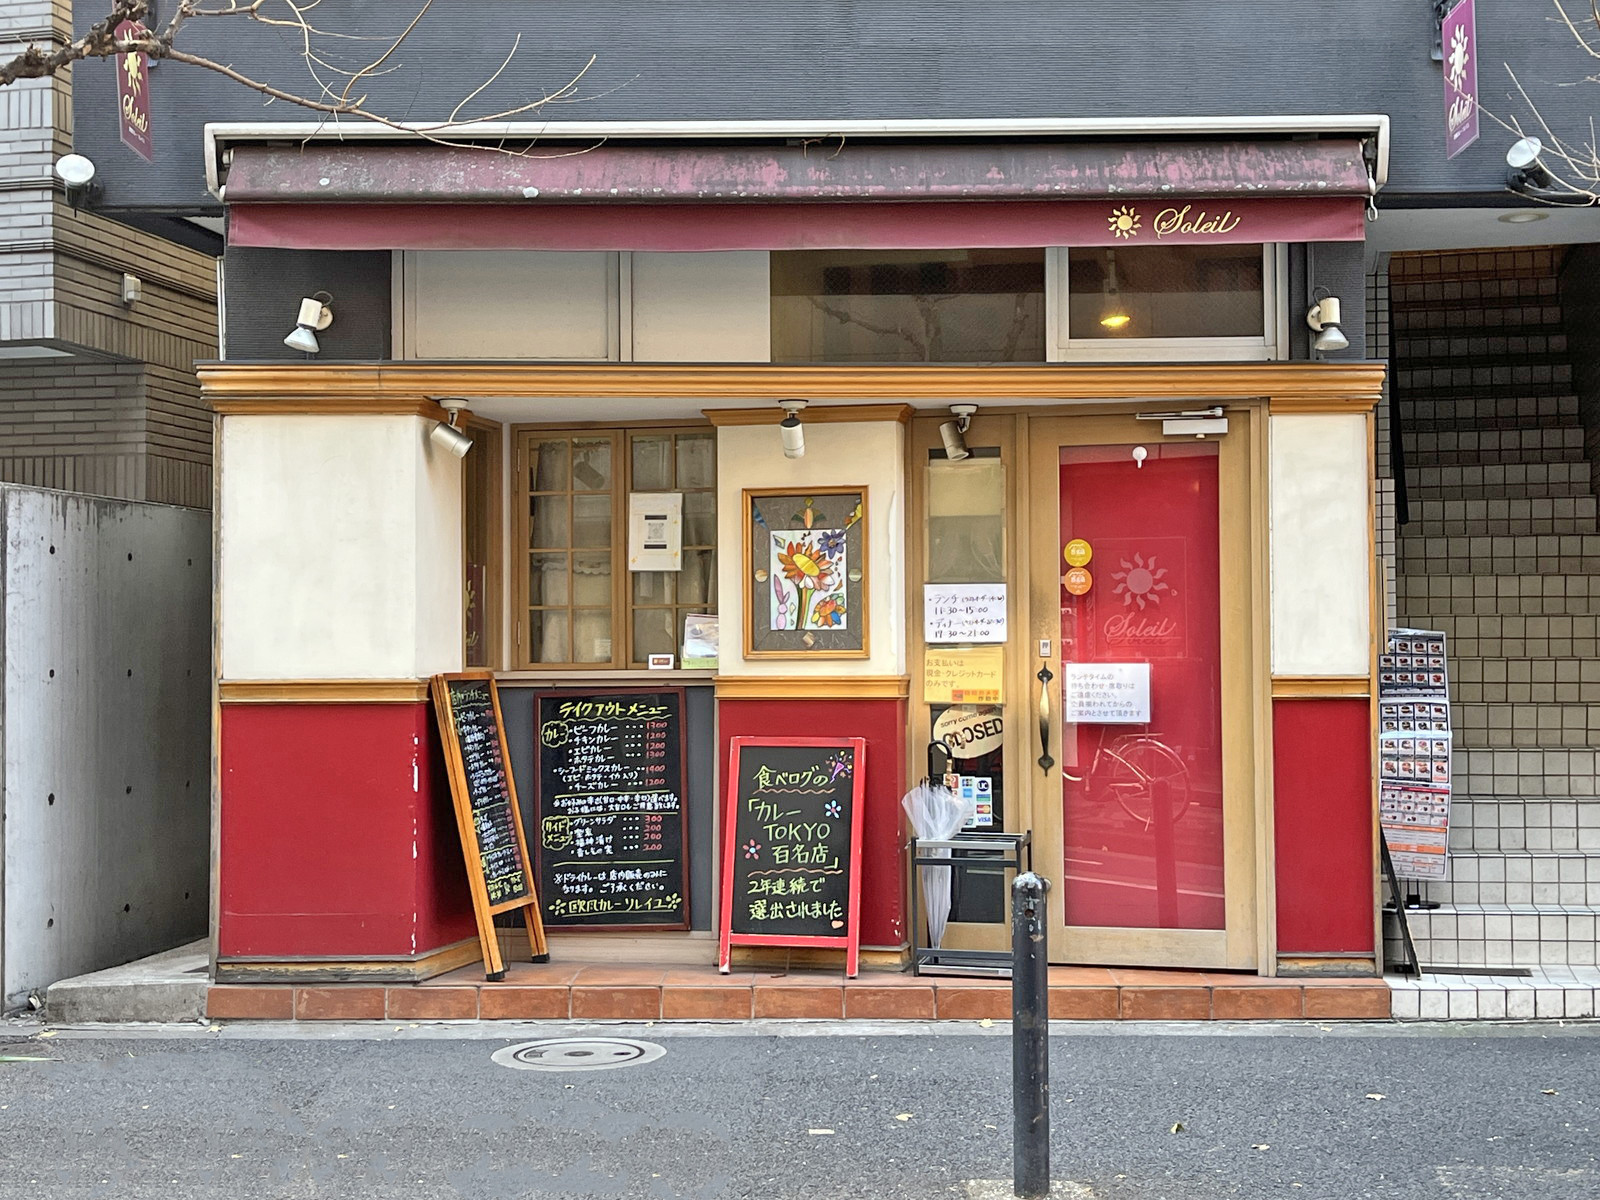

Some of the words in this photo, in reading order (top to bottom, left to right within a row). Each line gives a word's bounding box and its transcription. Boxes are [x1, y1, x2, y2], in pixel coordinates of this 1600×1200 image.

[1153, 204, 1241, 240] Soleil
[1104, 611, 1177, 643] Soleil
[544, 730, 566, 742] カレー
[752, 765, 829, 789] 食べログの
[546, 834, 570, 844] メニュー
[763, 823, 831, 842] TOKYO
[747, 878, 826, 896] 2年連続で
[748, 900, 844, 920] 選出されました
